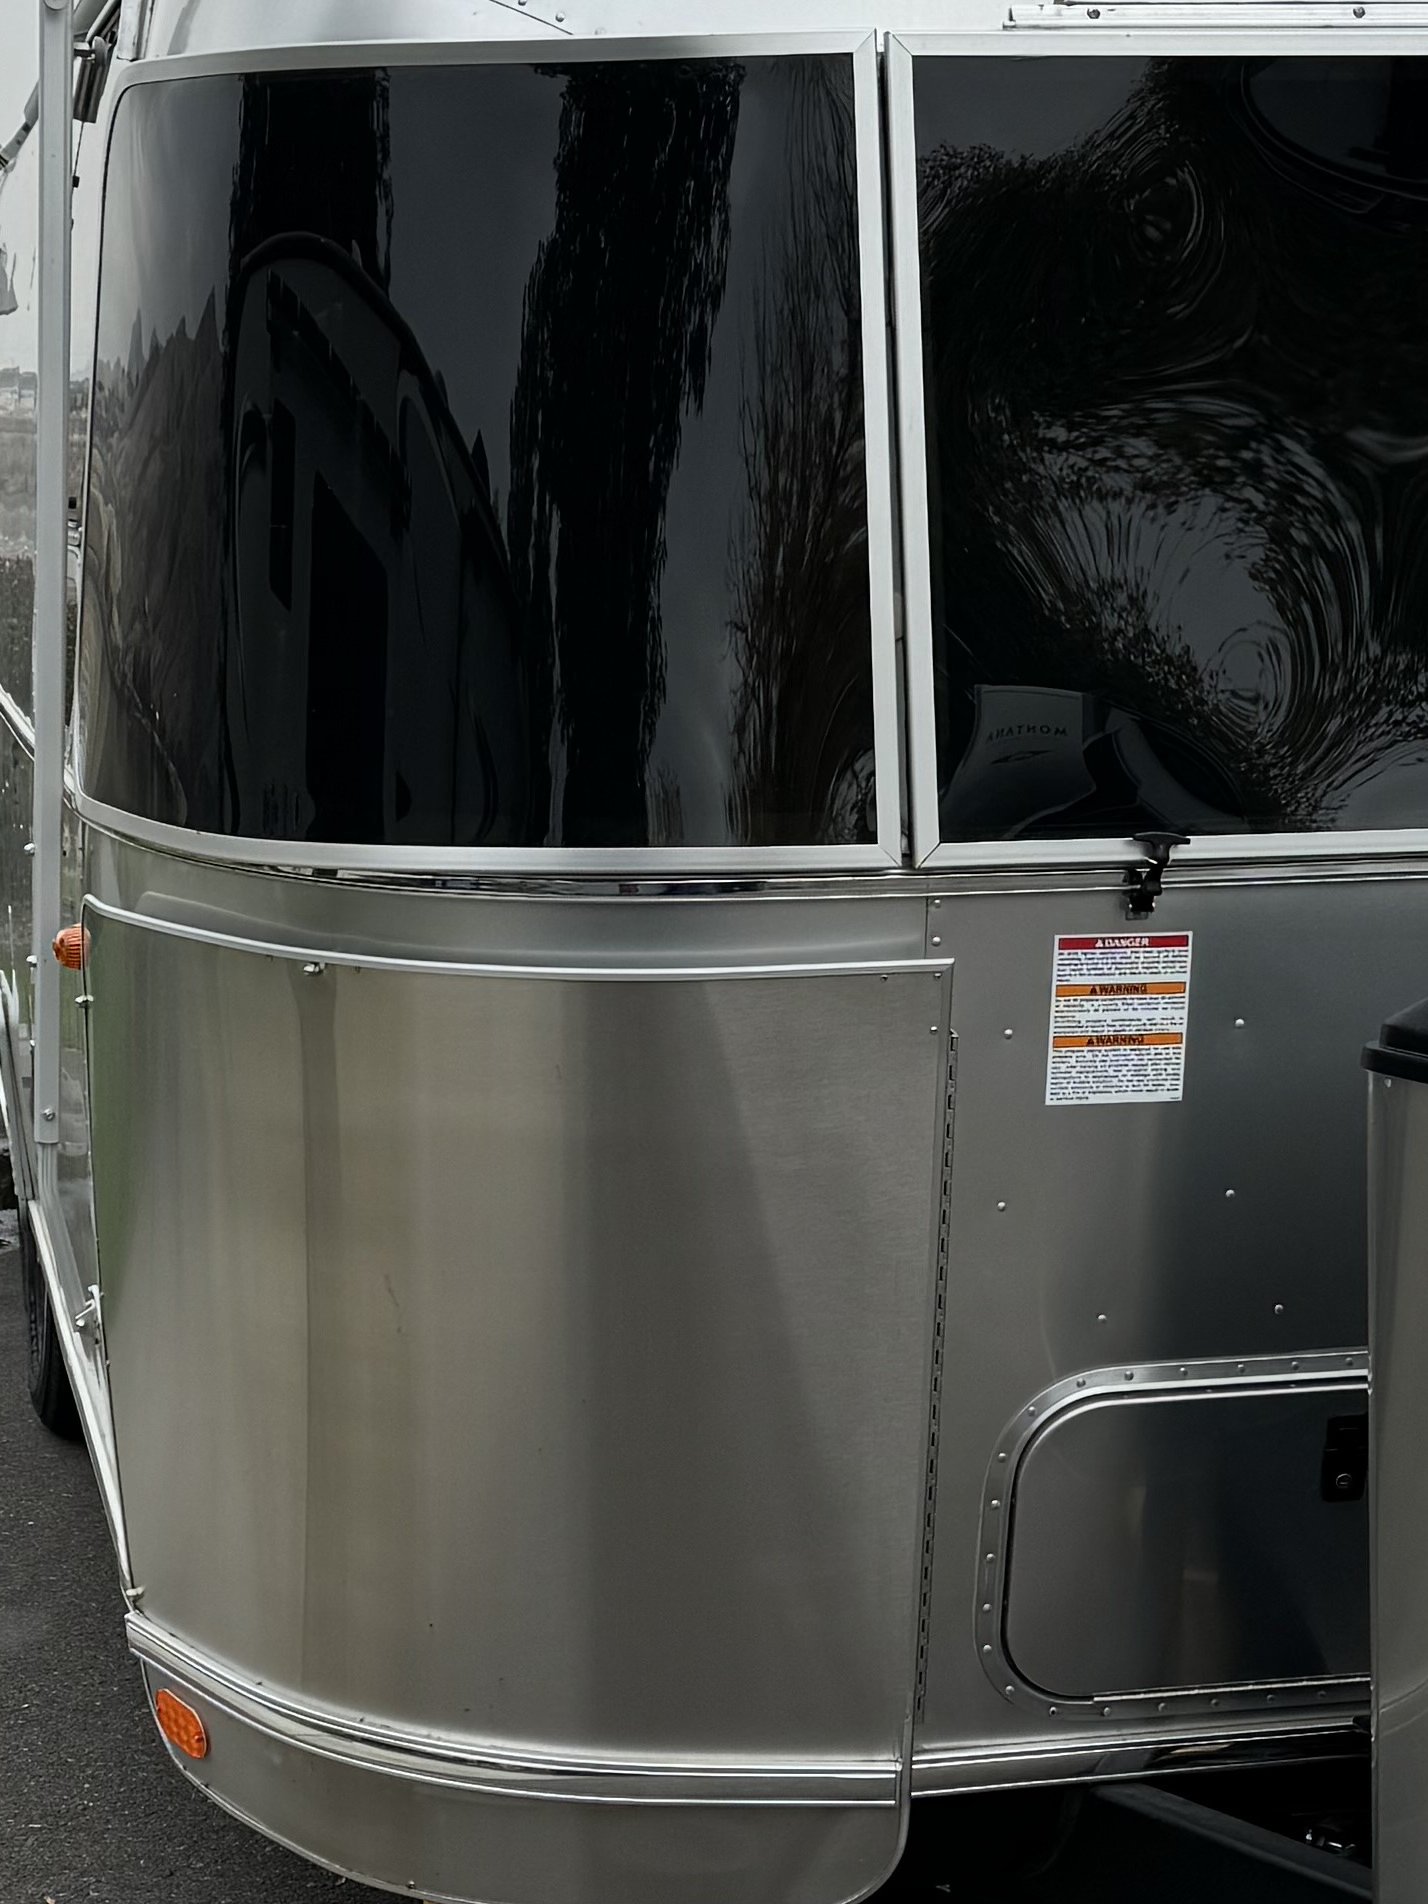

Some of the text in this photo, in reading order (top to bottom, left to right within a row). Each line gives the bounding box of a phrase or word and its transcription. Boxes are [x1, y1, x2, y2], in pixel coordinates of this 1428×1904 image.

[1104, 937, 1150, 947] DANGER
[1099, 984, 1147, 995] WARNING
[1095, 1034, 1145, 1046] WARNING
